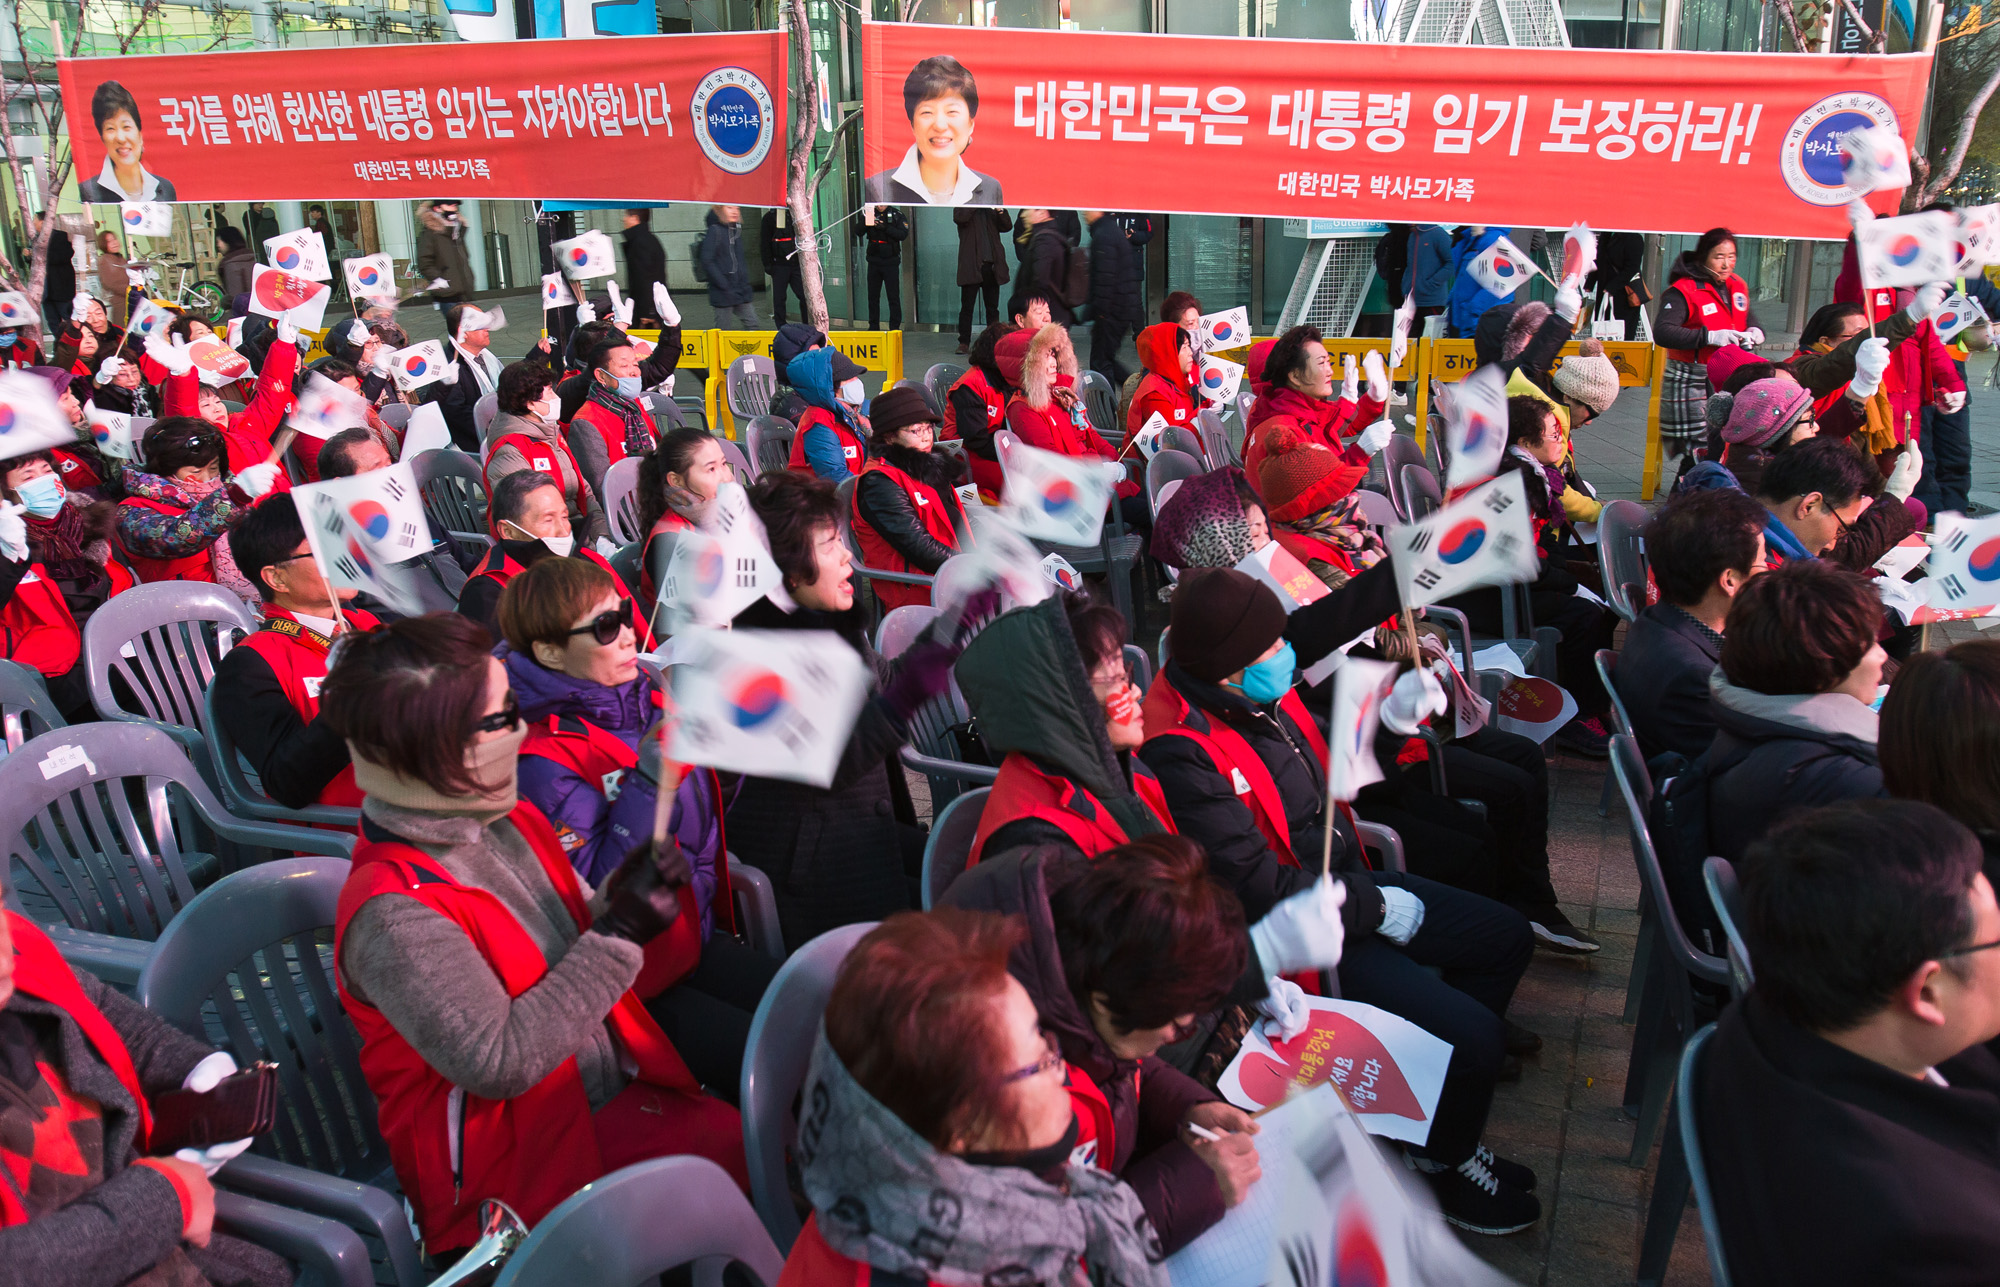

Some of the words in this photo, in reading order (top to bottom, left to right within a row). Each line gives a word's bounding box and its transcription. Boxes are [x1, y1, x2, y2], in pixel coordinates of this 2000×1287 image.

[159, 95, 231, 146] 국가를
[232, 93, 284, 144] 위해
[282, 90, 357, 142] 헌신한
[358, 88, 434, 142] 대통령
[437, 86, 515, 139] 임기는
[518, 82, 673, 139] 지켜야합니다
[708, 113, 760, 129] 박사모가족
[1014, 81, 1249, 146] 대한민국은
[1268, 89, 1411, 153] 대통령
[1433, 93, 1528, 156] 임기
[1540, 98, 1763, 165] 보장하라!
[354, 160, 412, 181] 대한민국
[415, 159, 490, 180] 박사모가족
[1278, 171, 1361, 198] 대한민국
[1370, 175, 1475, 203] 박사모가족
[271, 620, 301, 635] D810
